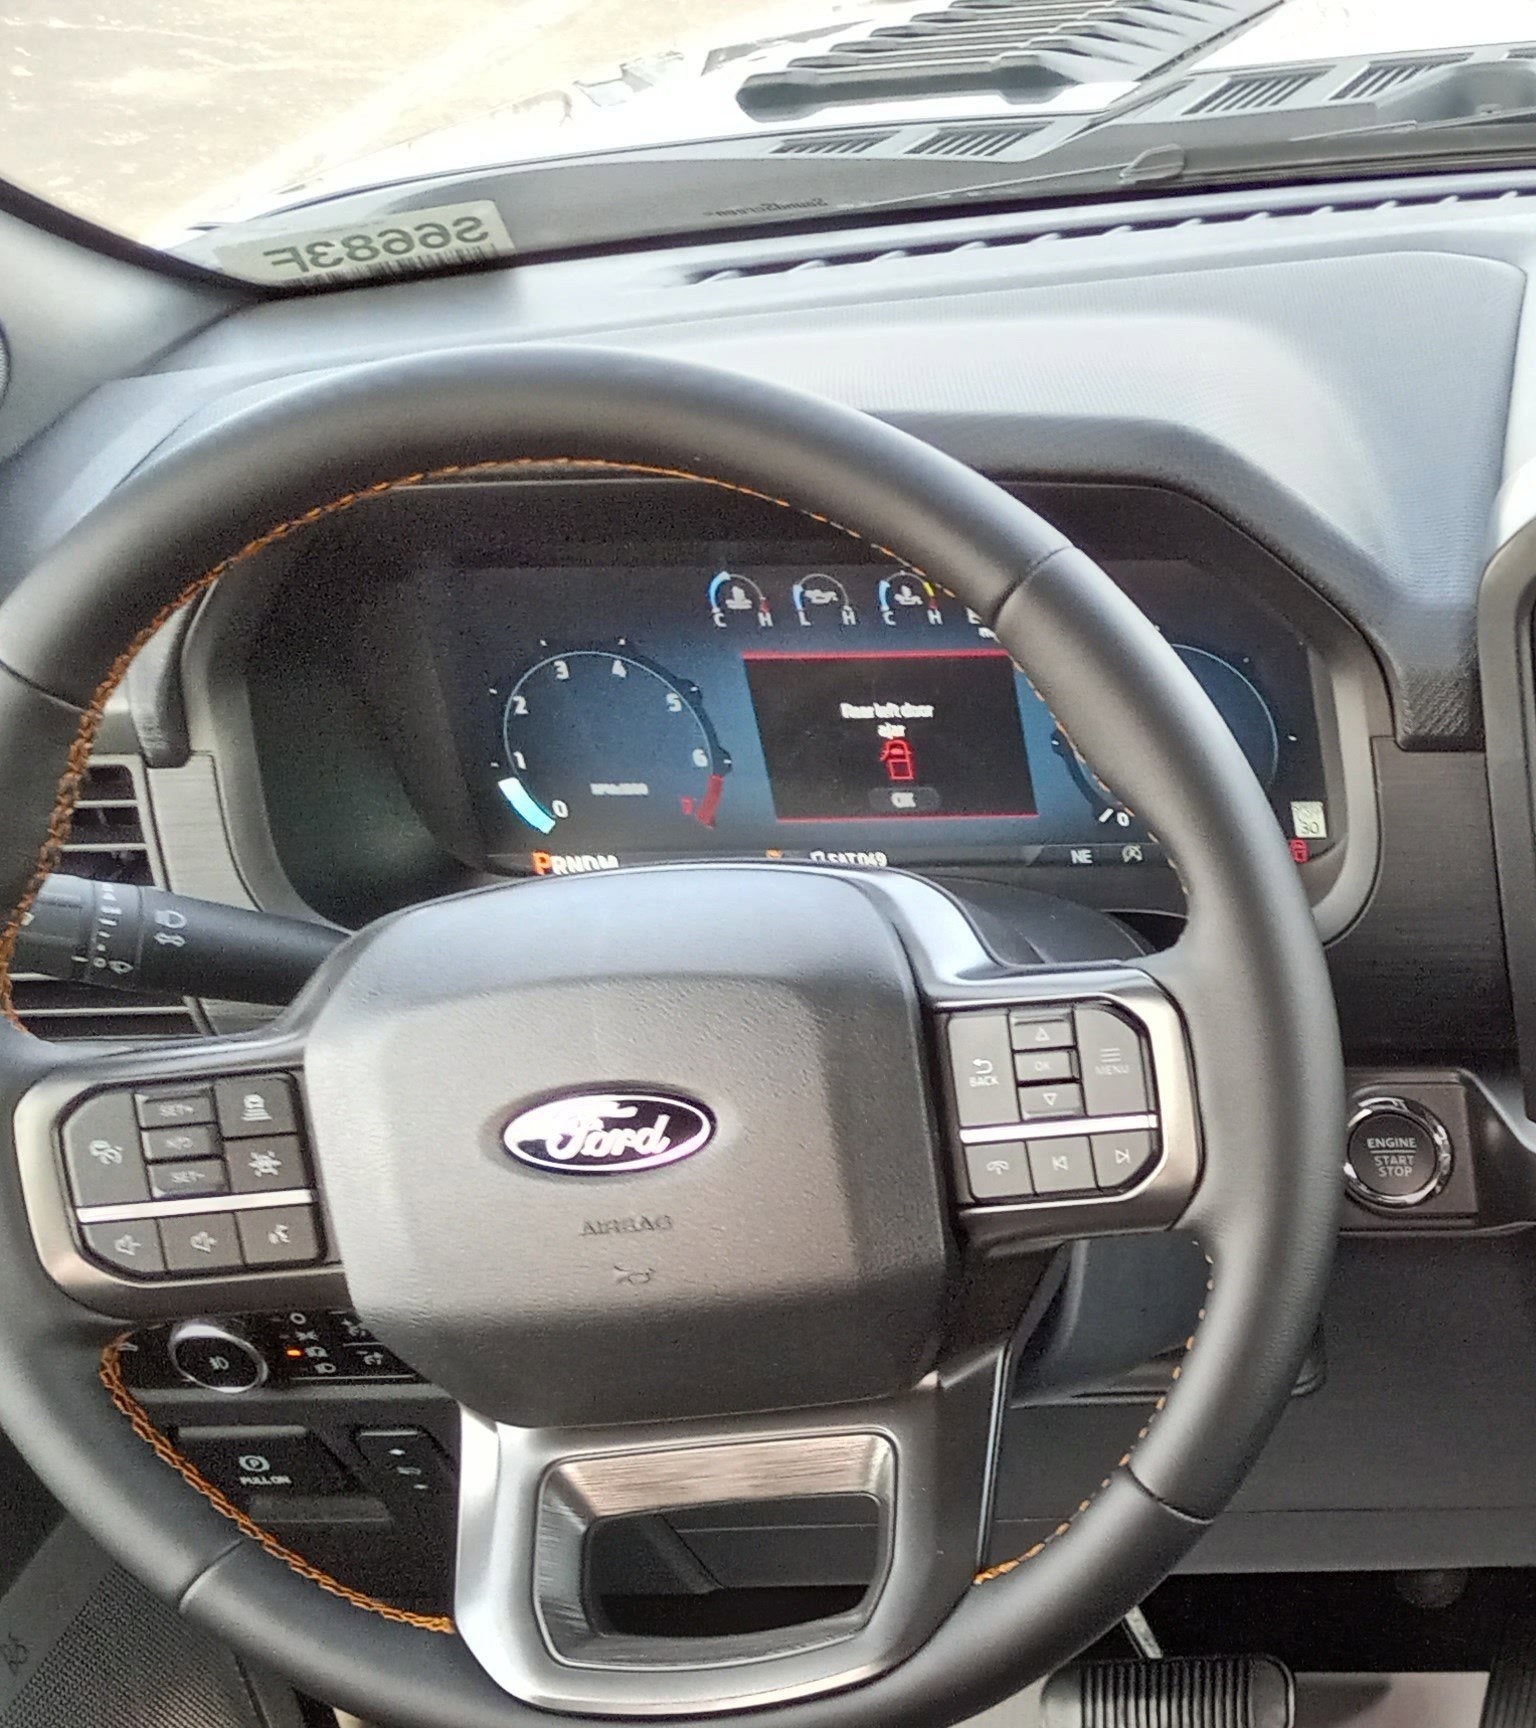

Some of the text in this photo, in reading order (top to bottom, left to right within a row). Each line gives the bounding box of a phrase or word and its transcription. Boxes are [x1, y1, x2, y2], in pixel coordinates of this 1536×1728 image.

[554, 660, 569, 680] 3
[612, 659, 627, 678] 4
[513, 696, 529, 715] 2
[666, 693, 682, 712] 5
[513, 751, 527, 770] 1
[692, 748, 708, 767] 6
[552, 800, 568, 818] 0
[1071, 849, 1093, 864] NE
[1367, 1137, 1417, 1149] ENGINE
[1374, 1155, 1415, 1166] START
[1379, 1165, 1412, 1177] STOP
